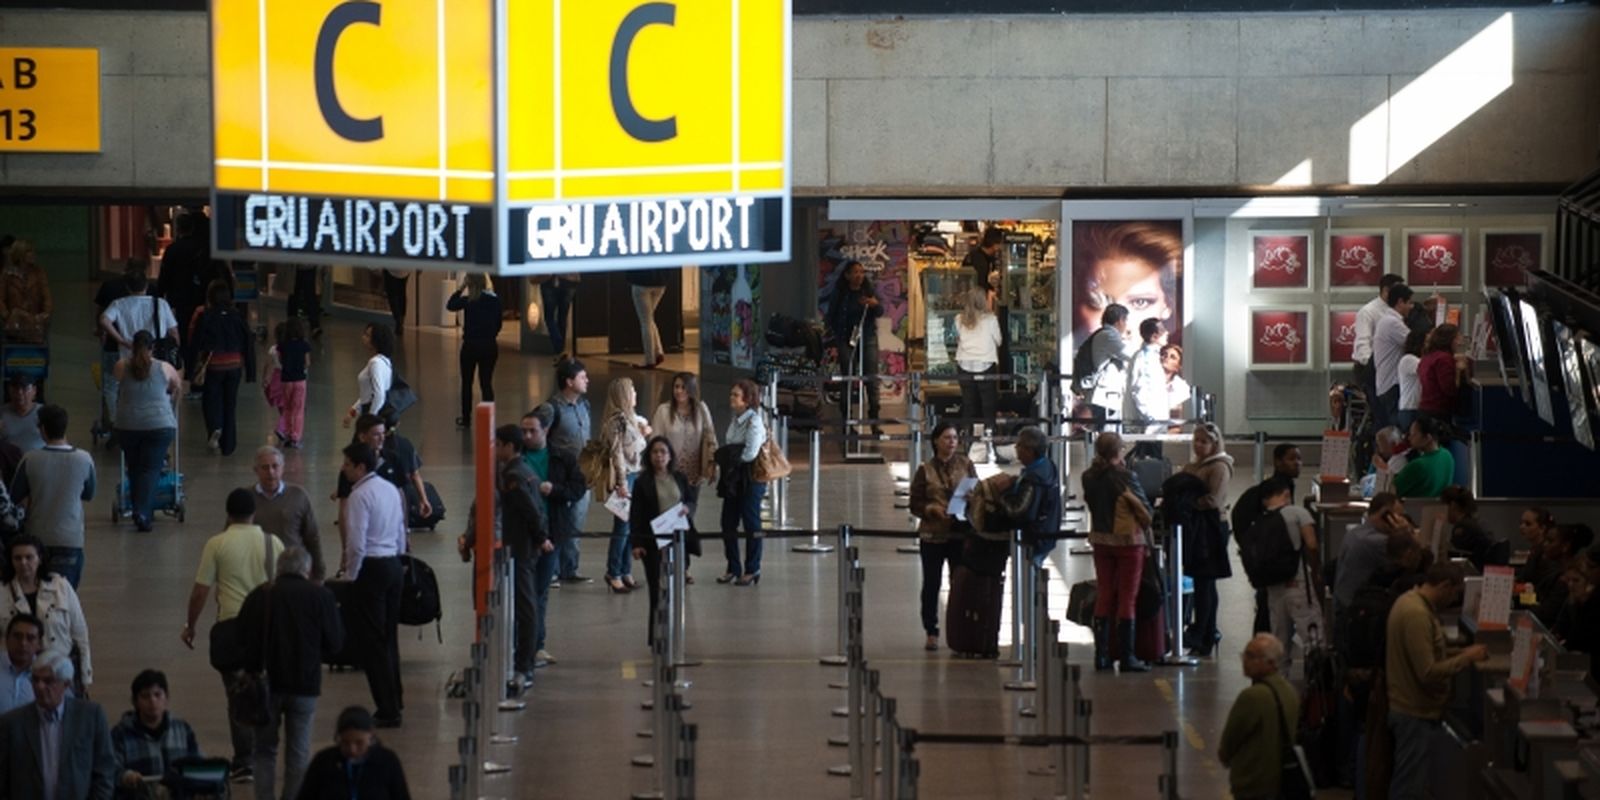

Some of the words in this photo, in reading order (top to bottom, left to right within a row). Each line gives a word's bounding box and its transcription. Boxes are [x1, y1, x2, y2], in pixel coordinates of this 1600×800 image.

[14, 57, 38, 90] B
[314, 1, 384, 142] C
[609, 2, 678, 142] C
[245, 194, 309, 249] GRU
[313, 198, 470, 258] AIRPORT
[527, 203, 595, 259] GRU
[599, 197, 754, 255] AIRPORT
